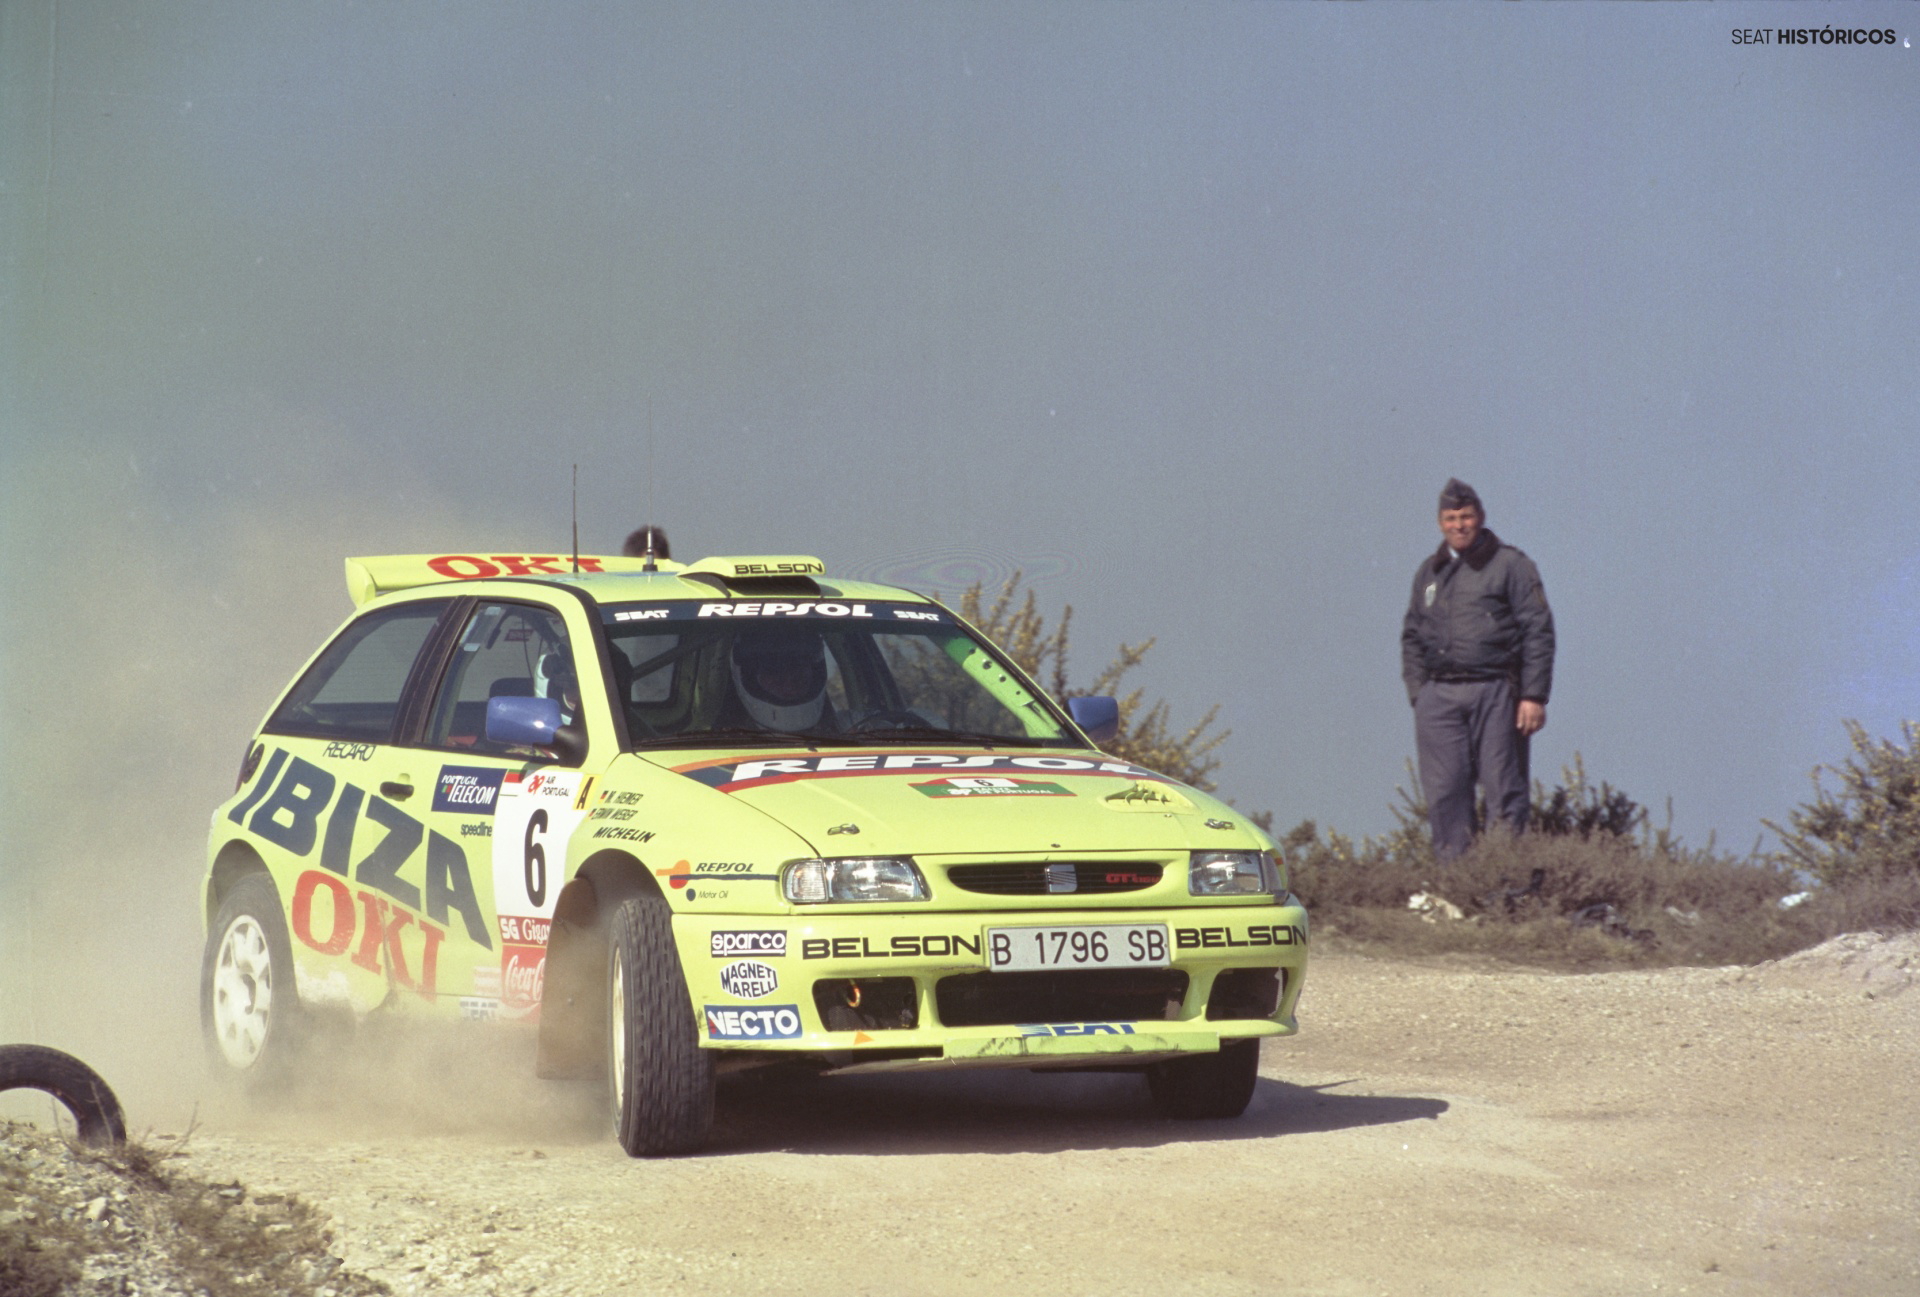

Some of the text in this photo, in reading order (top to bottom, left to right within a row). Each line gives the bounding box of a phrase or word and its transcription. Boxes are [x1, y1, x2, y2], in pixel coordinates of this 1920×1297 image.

[427, 555, 605, 579] OKI
[734, 563, 824, 575] BELSON
[614, 610, 670, 622] SEAT
[697, 603, 874, 618] REPSOL
[893, 610, 940, 621] SEAT
[322, 741, 377, 762] RECARO
[441, 774, 478, 785] PORTUGAL
[731, 754, 1148, 782] REPSOL
[447, 775, 497, 805] TELECOM
[541, 786, 571, 797] PORTUGAL
[973, 779, 994, 787] 6
[460, 821, 493, 838] speedline
[592, 826, 657, 843] MICHELIN
[227, 746, 494, 952] IBIZA
[524, 808, 549, 908] 6
[695, 862, 754, 873] REPSOL
[698, 889, 729, 899] Motor Oil
[291, 869, 446, 1004] OKI
[500, 917, 550, 944] SG Giga
[1175, 924, 1307, 949] BELSON
[711, 932, 786, 956] sparco
[801, 934, 981, 960] BELSON
[992, 929, 1166, 966] B 1796 SB
[720, 962, 778, 987] MAGNETI
[720, 974, 778, 998] MARELLI
[707, 1009, 799, 1037] VECTO
